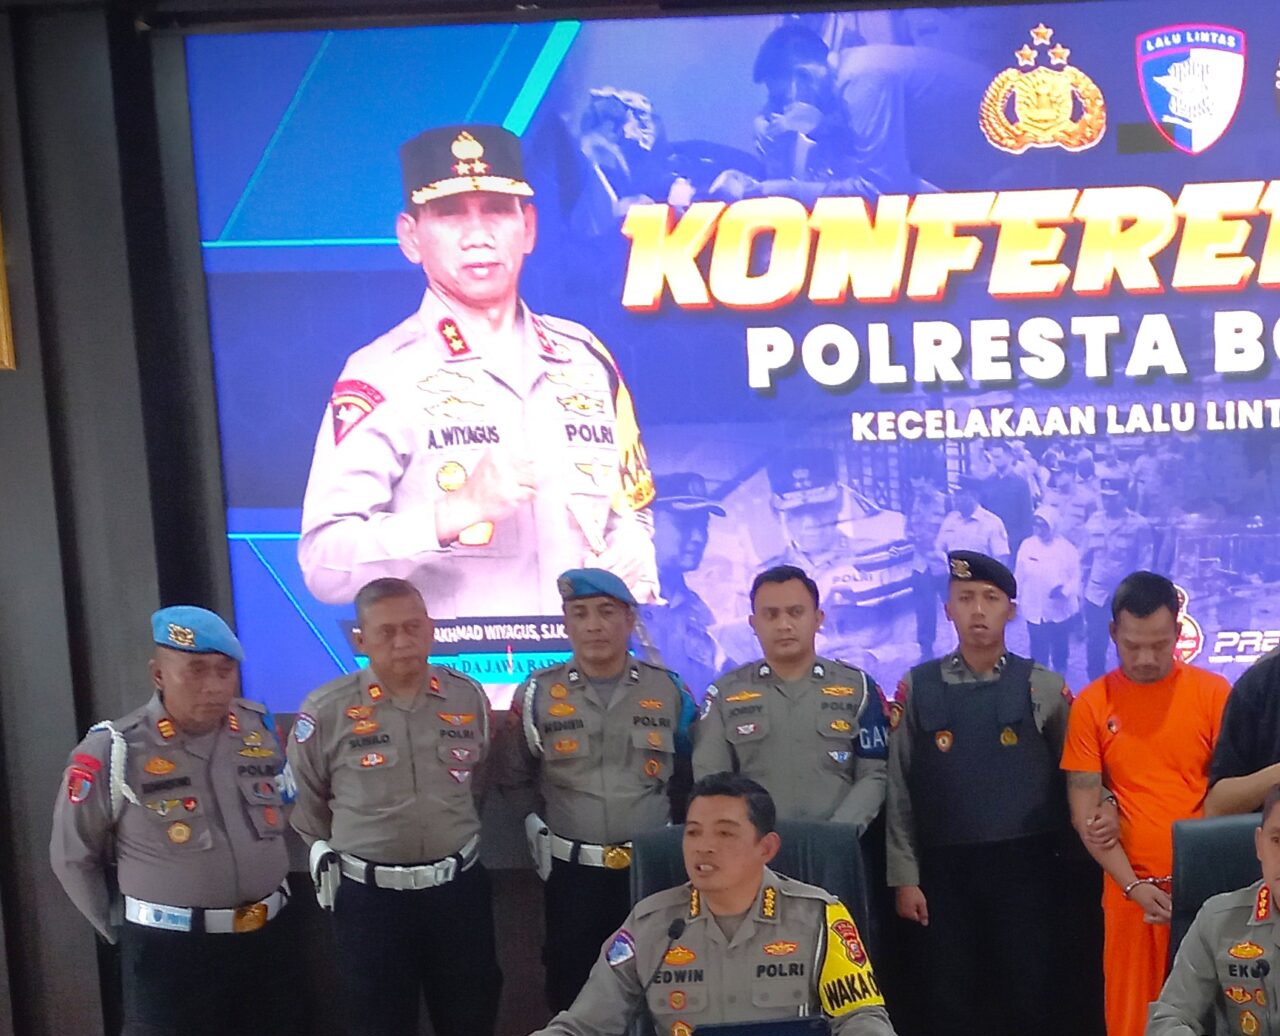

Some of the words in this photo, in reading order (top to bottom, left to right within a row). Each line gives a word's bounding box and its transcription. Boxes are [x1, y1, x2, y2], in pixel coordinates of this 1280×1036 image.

[1146, 33, 1182, 51] LALU
[1186, 31, 1236, 48] LINTAS
[746, 313, 1188, 391] POLRESTA
[851, 405, 1097, 442] KECELAKAAN
[1106, 401, 1195, 435] LALU
[565, 424, 615, 445] POLRI
[633, 716, 671, 727] POLRI
[650, 968, 705, 985] EDWIN
[756, 963, 804, 978] POLRI
